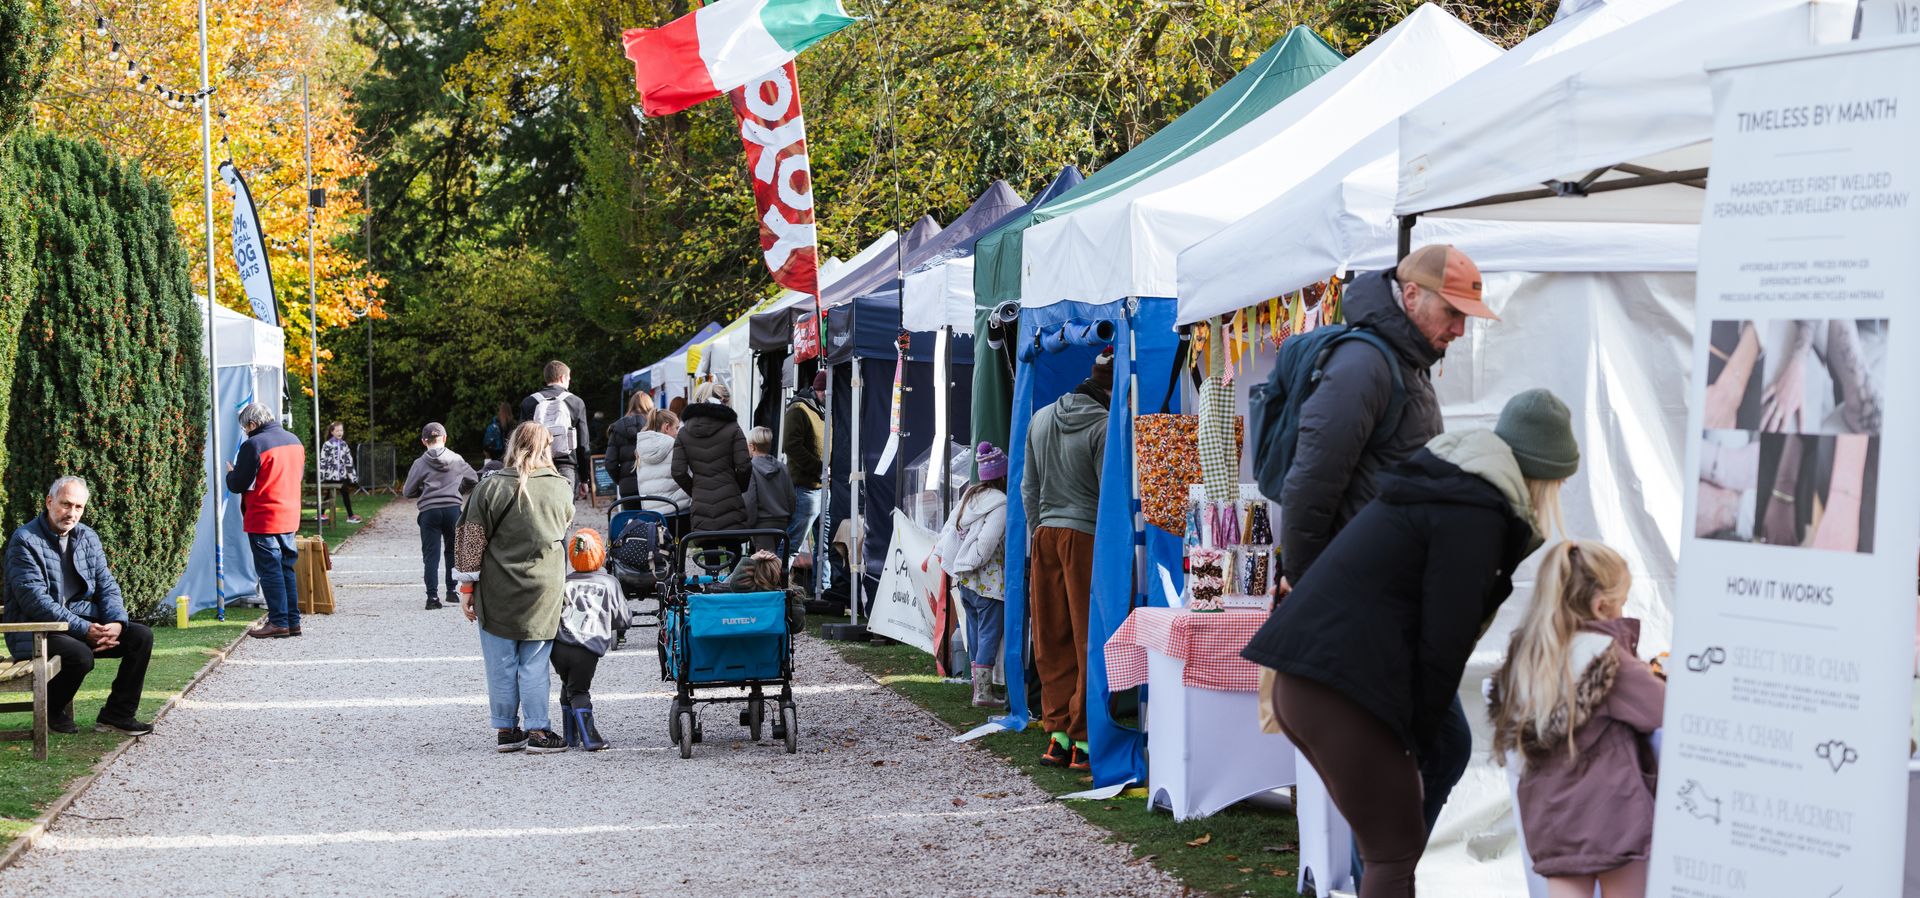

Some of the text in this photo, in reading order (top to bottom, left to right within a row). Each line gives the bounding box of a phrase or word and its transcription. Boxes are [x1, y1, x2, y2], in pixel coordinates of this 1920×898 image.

[1738, 98, 1898, 132] TIMELESS BY MANTH
[1730, 172, 1892, 197] HARROGATES FIRST WELDED
[1713, 192, 1910, 218] PERMANENT JEWELLERY COMPANY
[1727, 576, 1835, 606] HOW IT WORKS
[722, 617, 750, 625] FUXTEC
[1732, 647, 1860, 683] SELECT YOUR CHAIN
[1680, 713, 1795, 752] CHOOSE A CHARM
[1731, 789, 1854, 835] PICK A PLACEMENT
[1672, 854, 1708, 882] WELD
[1710, 863, 1724, 886] IT
[1726, 866, 1748, 892] ON
